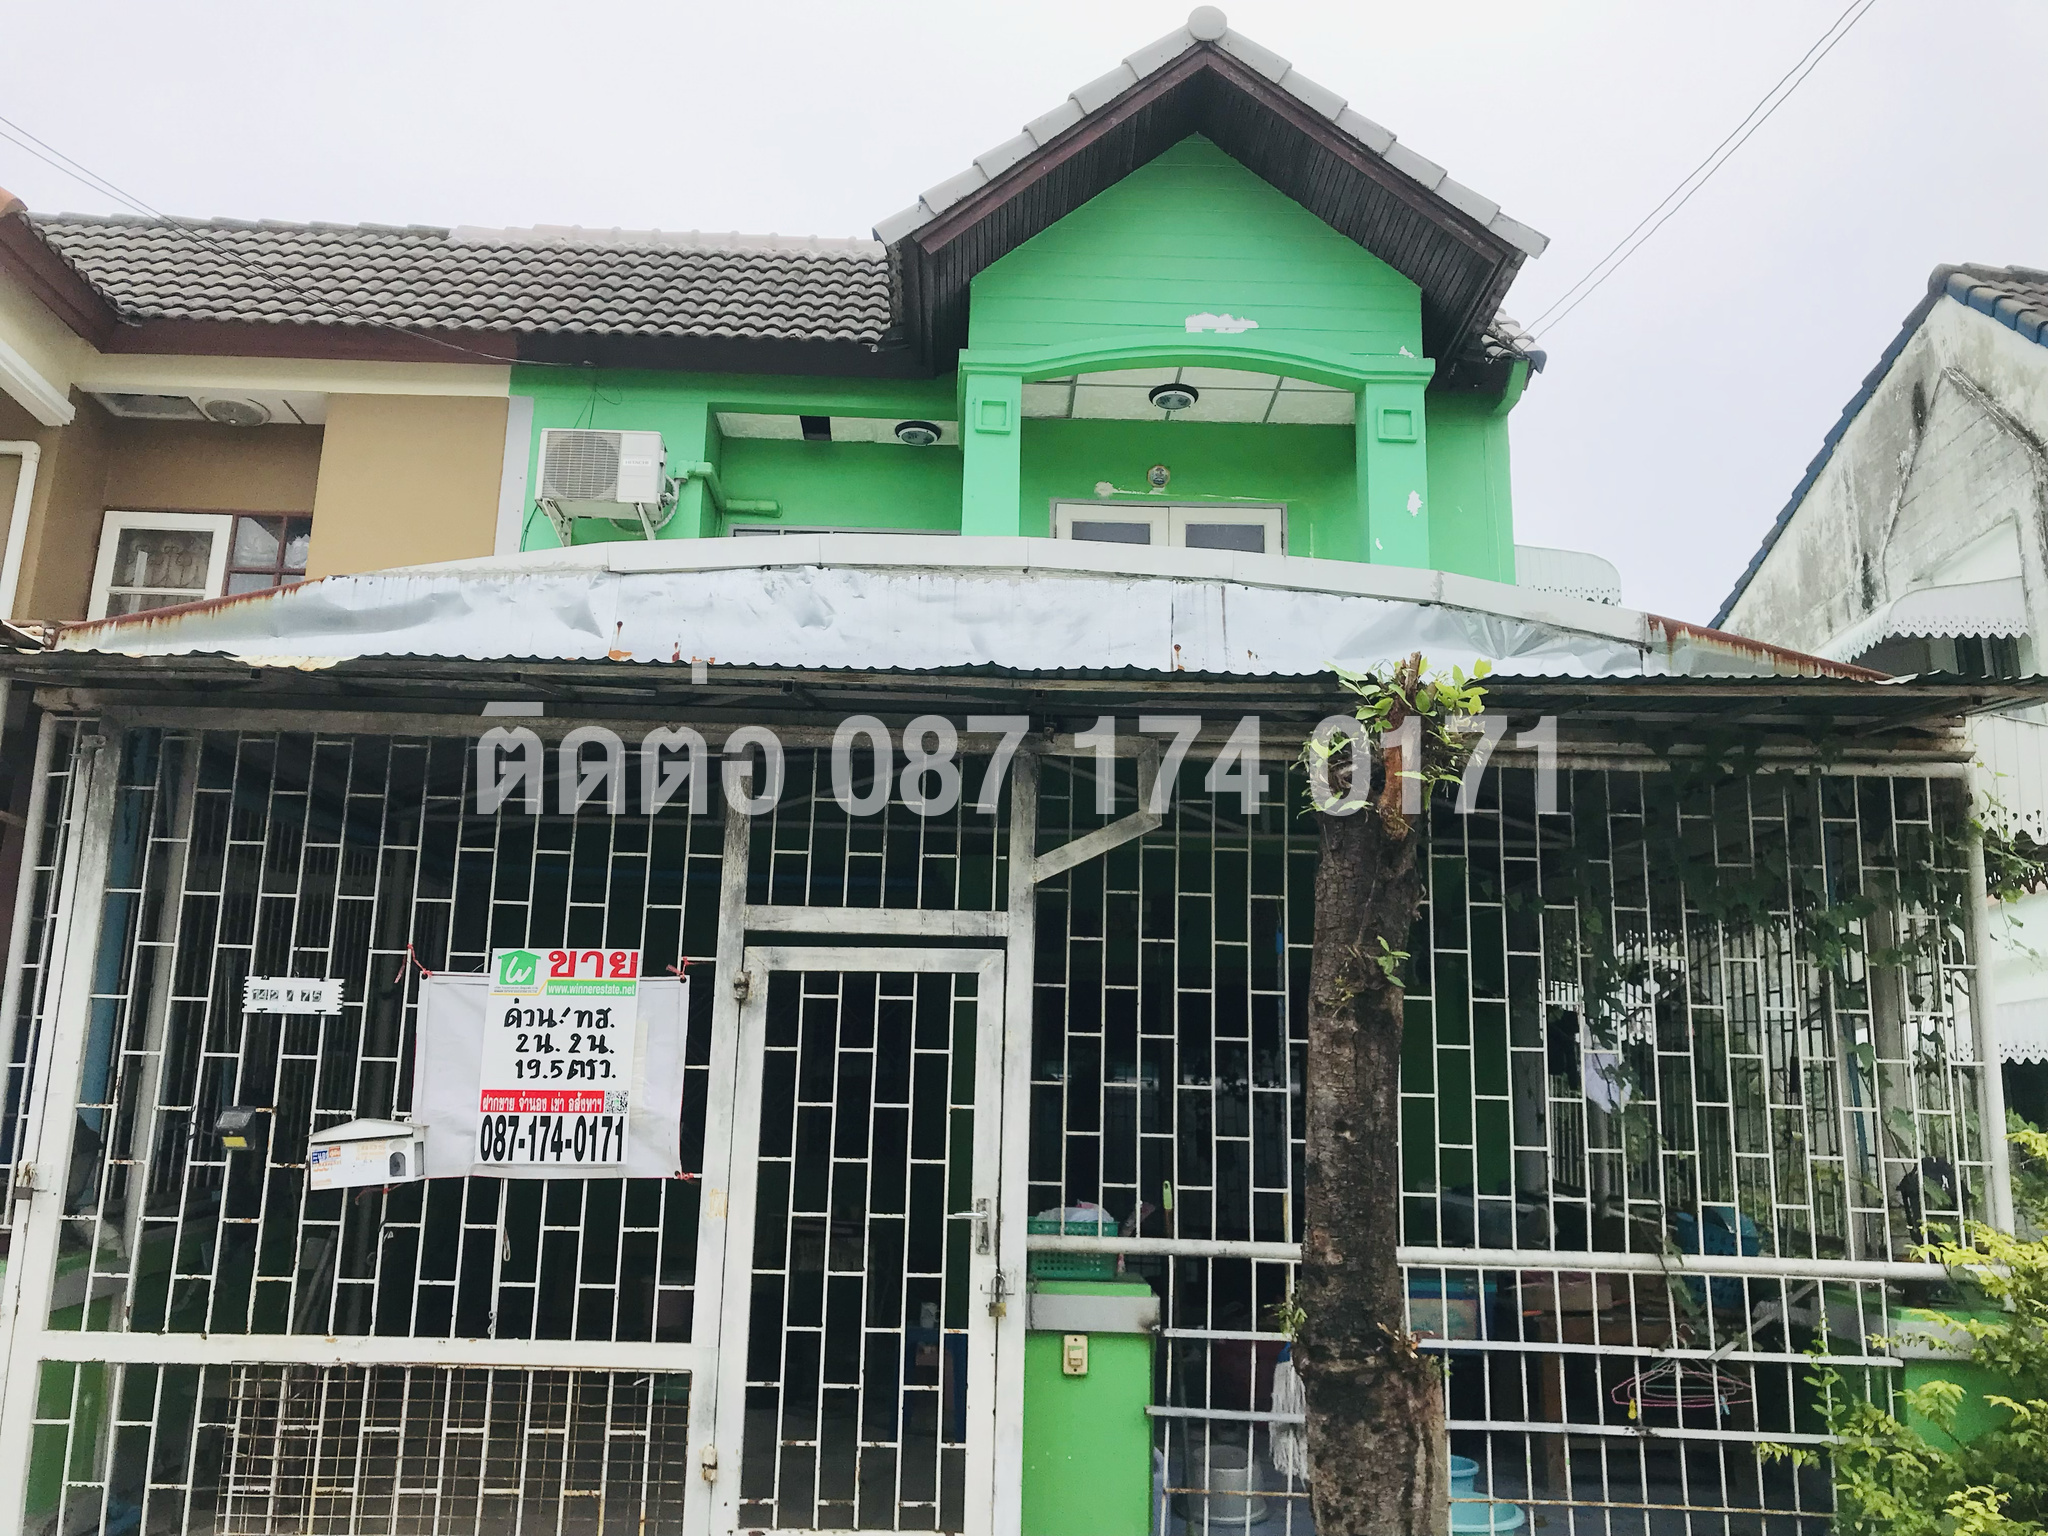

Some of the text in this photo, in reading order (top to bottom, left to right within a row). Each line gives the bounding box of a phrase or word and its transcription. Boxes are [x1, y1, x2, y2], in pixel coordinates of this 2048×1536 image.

[548, 950, 638, 978] ขาย
[548, 983, 635, 995] www.winnerestate.net
[482, 1094, 515, 1112] ฝากขาย
[518, 1091, 547, 1112] จำนอง
[550, 1092, 565, 1112] เช่า
[480, 1114, 624, 1162] 087-174-0171
